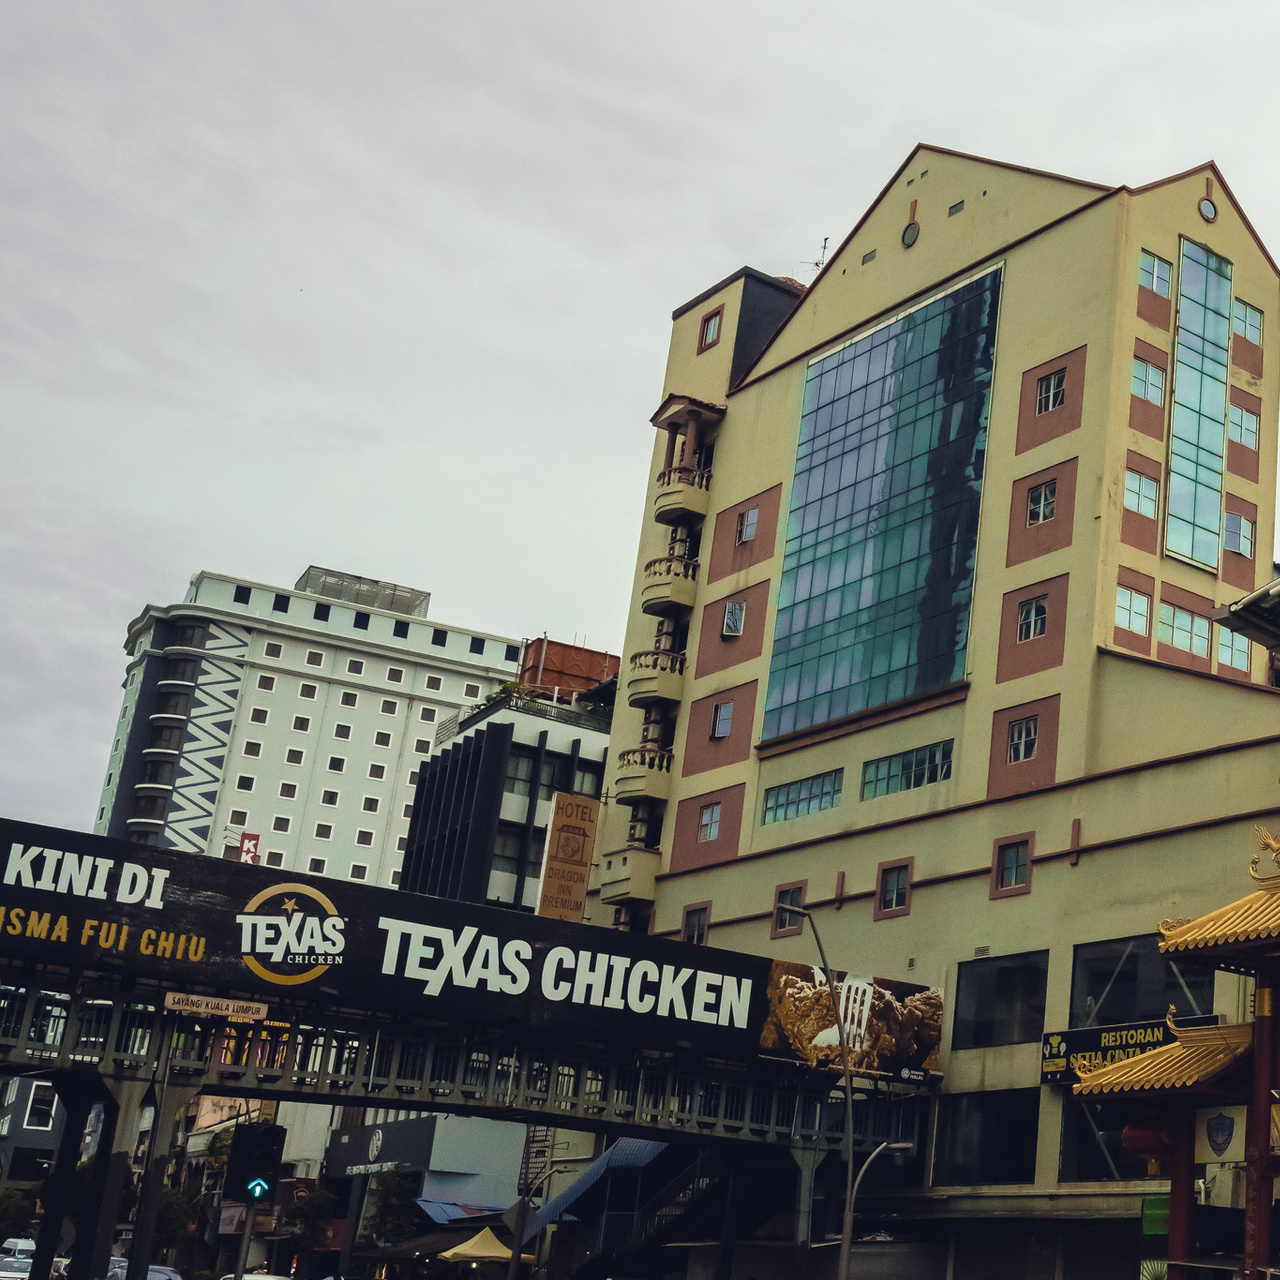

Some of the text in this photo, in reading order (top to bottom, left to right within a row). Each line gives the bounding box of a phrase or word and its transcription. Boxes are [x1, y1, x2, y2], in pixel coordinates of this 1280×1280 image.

[556, 802, 594, 823] HOTEL
[3, 843, 171, 910] KINI DI
[547, 867, 585, 884] DRAGON
[556, 883, 572, 896] INN
[542, 894, 582, 912] PREMIUM
[80, 918, 130, 952] FUI
[140, 928, 206, 962] CHIU
[235, 912, 346, 962] TEXAS
[287, 954, 344, 965] CHICKEN
[378, 916, 753, 1029] TEXAS CHICKEN
[171, 996, 261, 1015] SAYANGI KUALA LUMPUR
[1100, 1027, 1164, 1048] RESTORAN
